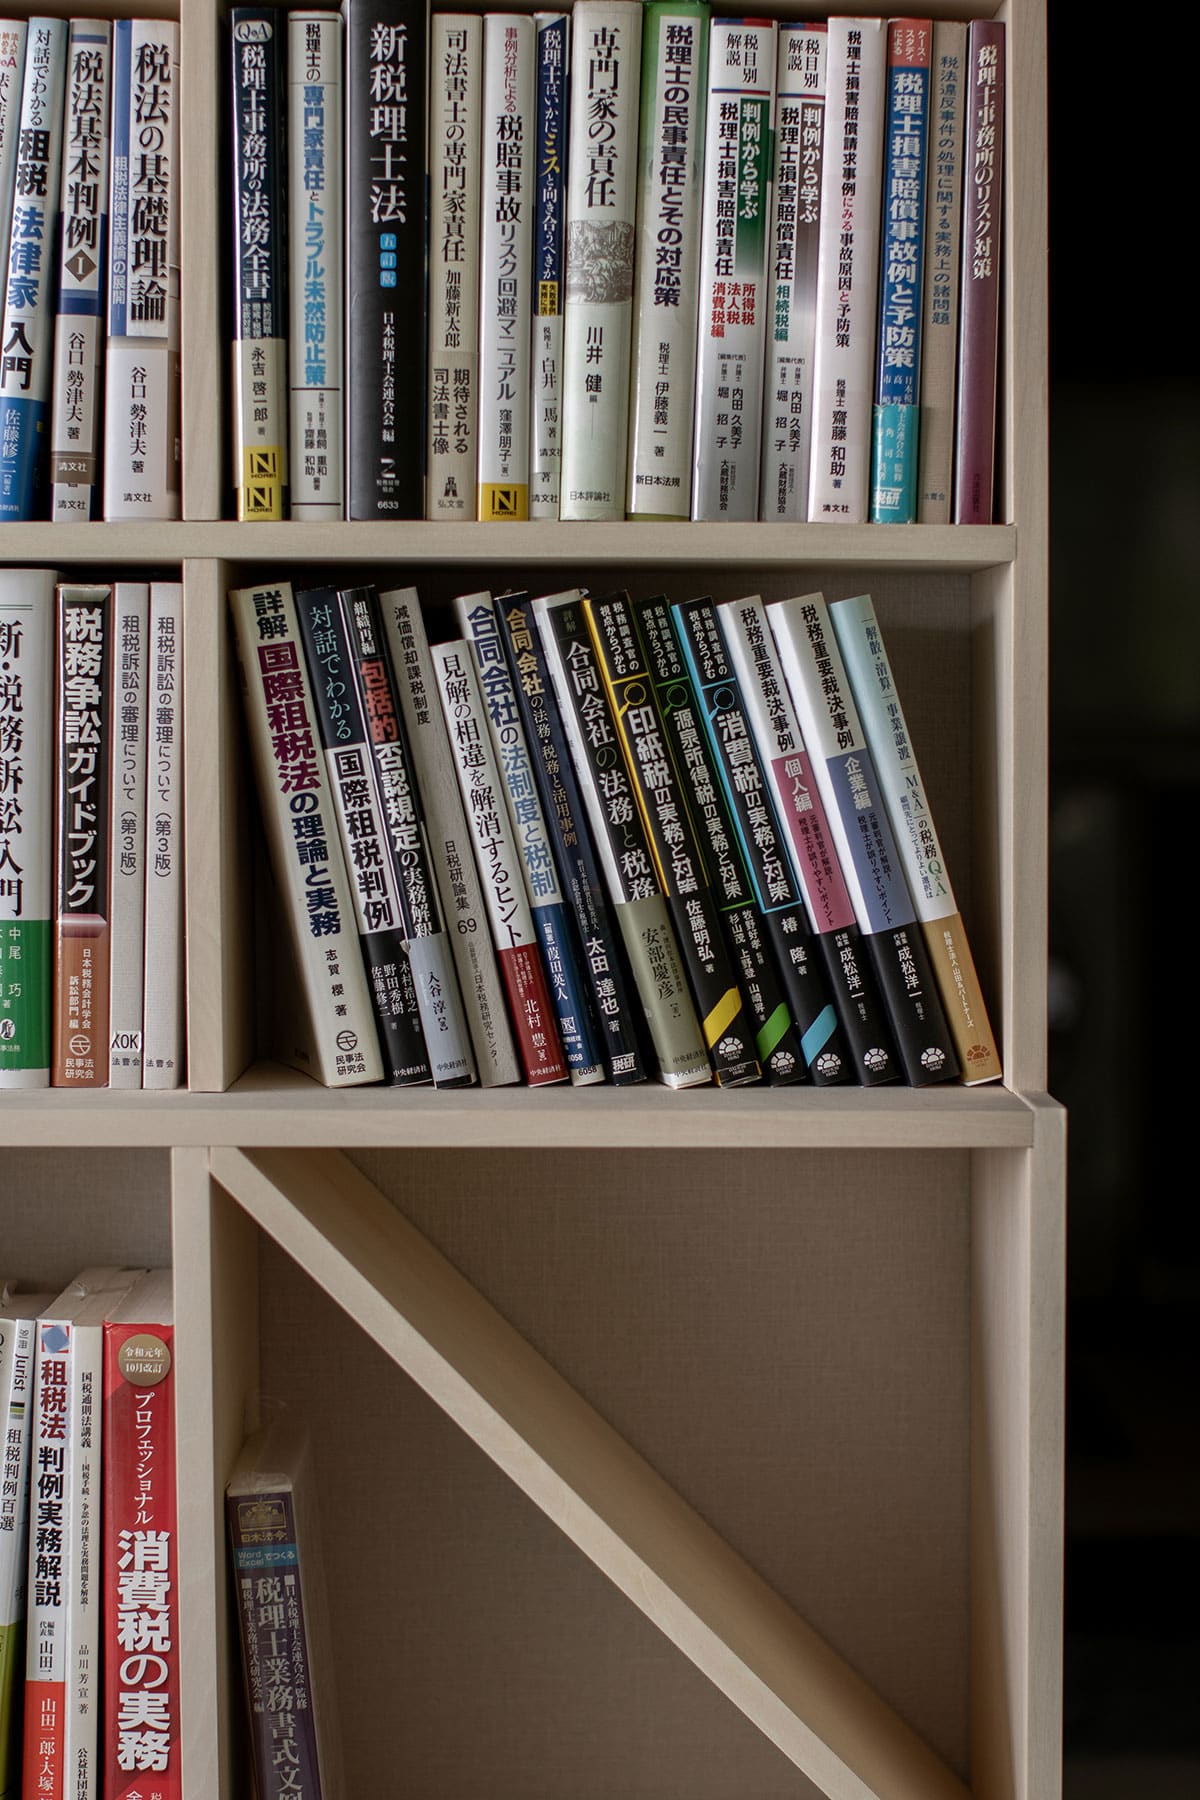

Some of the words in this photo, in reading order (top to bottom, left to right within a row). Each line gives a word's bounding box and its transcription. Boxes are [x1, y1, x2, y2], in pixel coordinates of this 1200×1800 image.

[306, 24, 322, 82] 税理士の
[504, 27, 518, 112] 事例分析による
[726, 33, 742, 66] 解説
[742, 34, 758, 83] 税目別
[788, 38, 804, 72] 解説
[804, 39, 820, 88] 税目別
[893, 30, 903, 56] による
[30, 30, 52, 127] 対話でわかる
[370, 23, 408, 224] 新税理士法
[584, 27, 620, 208] 専門家の責任
[66, 51, 104, 249] 税法基本判例
[240, 44, 272, 300] 税理士事務所の法務全書
[442, 30, 468, 263] 司法書士の専門家責任
[540, 30, 562, 280] 税理士はいかにミスと向き合うべきか
[654, 25, 694, 307] 税理士の民事責任とその対応策
[740, 103, 761, 220] 判例から学ぶ
[800, 108, 822, 224] 判例から学ぶ
[972, 45, 998, 280] 税理士事務所のリスク対策
[130, 44, 171, 322] 税法の基礎理論
[714, 102, 739, 276] 税理士損害賠償責任
[775, 107, 800, 280] 税理士損害賠償責任
[836, 30, 862, 348] 税理士損害賠償請求事例にみる事故原因と予防策
[932, 56, 958, 326] 税法違反事件の処理に関する実務上の諸問題
[304, 86, 326, 386] 専門家責任とトラブル未然防止策
[884, 73, 924, 368] 税理士損害賠償事故例と予防策
[496, 115, 523, 401] 税賠事故リスク回避マニュアル
[444, 269, 462, 348] 加藤新太郎
[710, 282, 726, 338] 消費税編
[726, 282, 742, 325] 法人税
[741, 283, 756, 326] 所得税
[774, 284, 790, 342] 相続税編
[68, 333, 86, 366] 谷口
[251, 348, 266, 376] 永吉
[382, 312, 396, 426] 日本税理士会連合会
[586, 326, 604, 364] 川井
[658, 342, 670, 376] 税理士
[66, 370, 84, 422] 勢津夫
[130, 367, 146, 400] 谷口
[542, 358, 557, 390] 白井
[585, 374, 602, 392] 健
[732, 388, 744, 410] 内田
[836, 378, 846, 408] 税理士
[252, 382, 268, 422] 啓一郎
[432, 368, 450, 454] 司法書士像
[453, 368, 470, 454] 期待される
[543, 399, 558, 423] 一馬
[652, 382, 670, 434] 伊藤義一
[790, 391, 802, 414] 内田
[67, 427, 80, 441] 著
[130, 405, 148, 456] 勢津夫
[382, 429, 395, 442] 編
[498, 409, 512, 462] 窪澤朋子
[654, 446, 664, 457] 著
[730, 415, 743, 449] 久美子
[788, 418, 802, 452] 久美子
[57, 462, 88, 472] 清文社
[132, 461, 145, 472] 著
[304, 456, 315, 476] 和助
[636, 476, 680, 488] 新日本法規
[830, 446, 846, 476] 和助
[57, 500, 87, 511] 清文社
[124, 492, 152, 502] 清文社
[377, 502, 399, 510] 6633
[570, 491, 610, 502] 日本評論社
[822, 504, 850, 514] 清文社
[252, 590, 289, 640] 詳解
[600, 605, 627, 675] 視点からつかむ
[612, 601, 640, 671] 税務調査官の
[654, 606, 682, 674] 税務調査官の
[394, 606, 430, 726] 減価償却課税制度
[642, 609, 670, 678] 視点からつかむ
[688, 611, 716, 680] 視点からつかむ
[702, 608, 729, 676] 税務調査官の
[740, 606, 796, 753] 税務重要裁決事例
[800, 604, 856, 750] 税務重要裁決事例
[506, 608, 578, 848] 合同会社の法務・税務と活用事例
[864, 626, 892, 692] 解散・清算
[906, 774, 924, 811] M&A
[64, 607, 104, 908] 税務争訟ガイドブック
[309, 604, 352, 741] 対話でわかる
[334, 748, 394, 932] 国際租税判例
[467, 605, 558, 898] 合同会社の法制度と税制
[566, 640, 656, 902] 合同会社の法務と税務
[257, 640, 342, 938] 国際租税法の理論と実務
[442, 654, 522, 947] 見解の相違を解消するヒント
[627, 705, 700, 894] 印紙税の実務と対策
[672, 708, 743, 900] 源泉所得税の実務と対策
[716, 710, 791, 904] 消費税の実務と対策
[784, 758, 814, 814] 個人編
[844, 756, 873, 812] 企業編
[445, 840, 471, 911] 日税研論集
[8, 926, 22, 960] 中尾
[456, 918, 478, 935] 69
[686, 899, 715, 962] 佐藤明弘
[782, 916, 799, 934] 椿
[586, 937, 610, 974] 太田
[642, 928, 674, 1000] 安部慶彦
[790, 946, 808, 964] 隆
[840, 947, 865, 999] 成松洋一
[897, 946, 923, 999] 成松洋一
[8, 983, 22, 998] 巧
[68, 975, 80, 1017] 訴訟部門
[82, 949, 92, 1029] 日本税務会計学会
[325, 948, 340, 976] 志賀
[334, 1004, 348, 1018] 著
[383, 962, 404, 1016] 野田秀樹
[432, 1002, 447, 1014] 淳
[596, 979, 620, 1016] 達也
[474, 976, 498, 1068] 日本税務研究センター
[525, 1000, 542, 1029] 北村
[531, 1032, 546, 1048] 豊
[608, 1020, 621, 1033] 著
[65, 1058, 95, 1068] 民事法
[65, 1069, 95, 1079] 研究会
[335, 1054, 364, 1066] 民事法
[337, 1063, 366, 1076] 研究会
[393, 1064, 427, 1079] 中央経済社
[578, 1066, 597, 1077] 6058
[14, 1354, 30, 1392] Jurist
[126, 1347, 164, 1357] 令和元年
[126, 1362, 162, 1373] 10月改訂
[40, 1359, 68, 1440] 租税法
[81, 1372, 92, 1448] 国税通則法講義
[0, 1428, 22, 1531] 租税判例百選
[134, 1392, 156, 1525] プロフェッショナル
[34, 1446, 64, 1608] 判例実務解説
[238, 1552, 262, 1560] Word
[264, 1551, 296, 1561] でつくる
[117, 1530, 172, 1771] 消費税の実務
[286, 1586, 306, 1685] 日本税理士会連合会
[78, 1645, 89, 1699] 品川芳宣
[79, 1704, 89, 1714] 著
